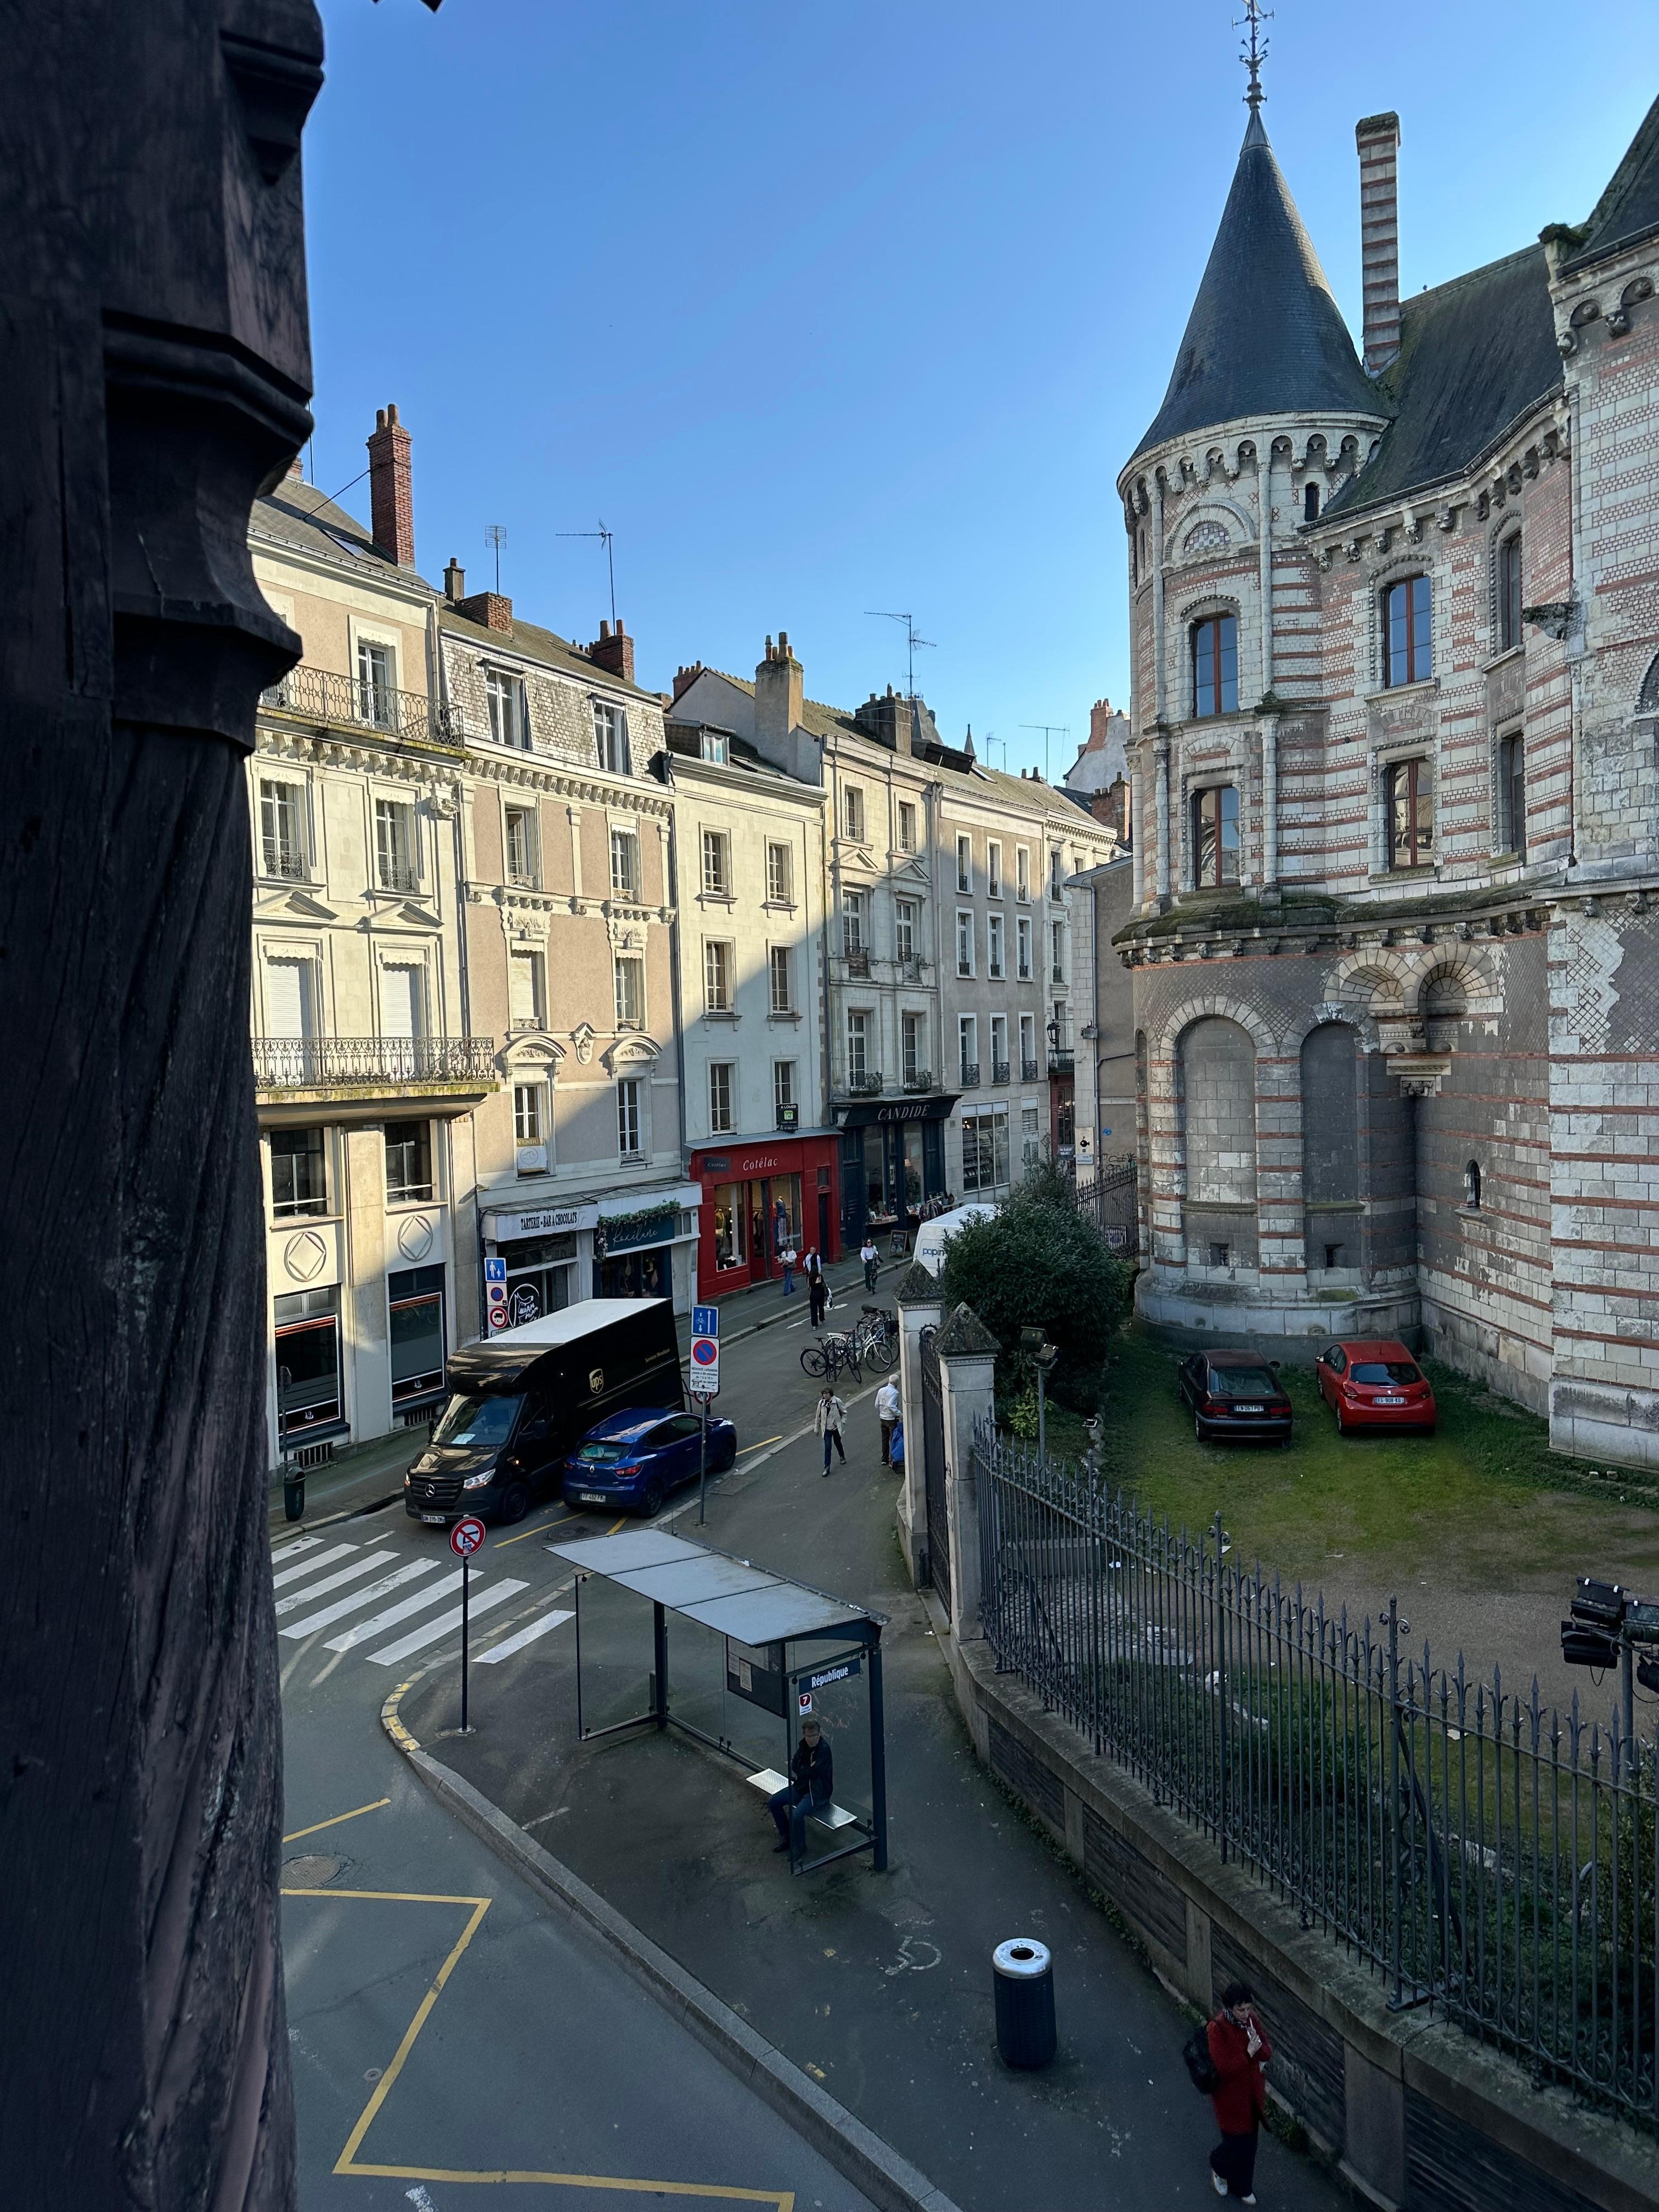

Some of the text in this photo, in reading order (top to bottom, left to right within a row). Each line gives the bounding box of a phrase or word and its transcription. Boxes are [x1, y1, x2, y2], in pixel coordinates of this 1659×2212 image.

[878, 1105, 930, 1120] CANDIDE
[521, 1216, 540, 1231] TARTERIE
[543, 1215, 551, 1228] BAR
[552, 1214, 555, 1226] A
[555, 1211, 577, 1226] CHOCOLATS
[591, 1375, 602, 1391] ups
[811, 1667, 849, 1688] République
[803, 1696, 808, 1705] 7
